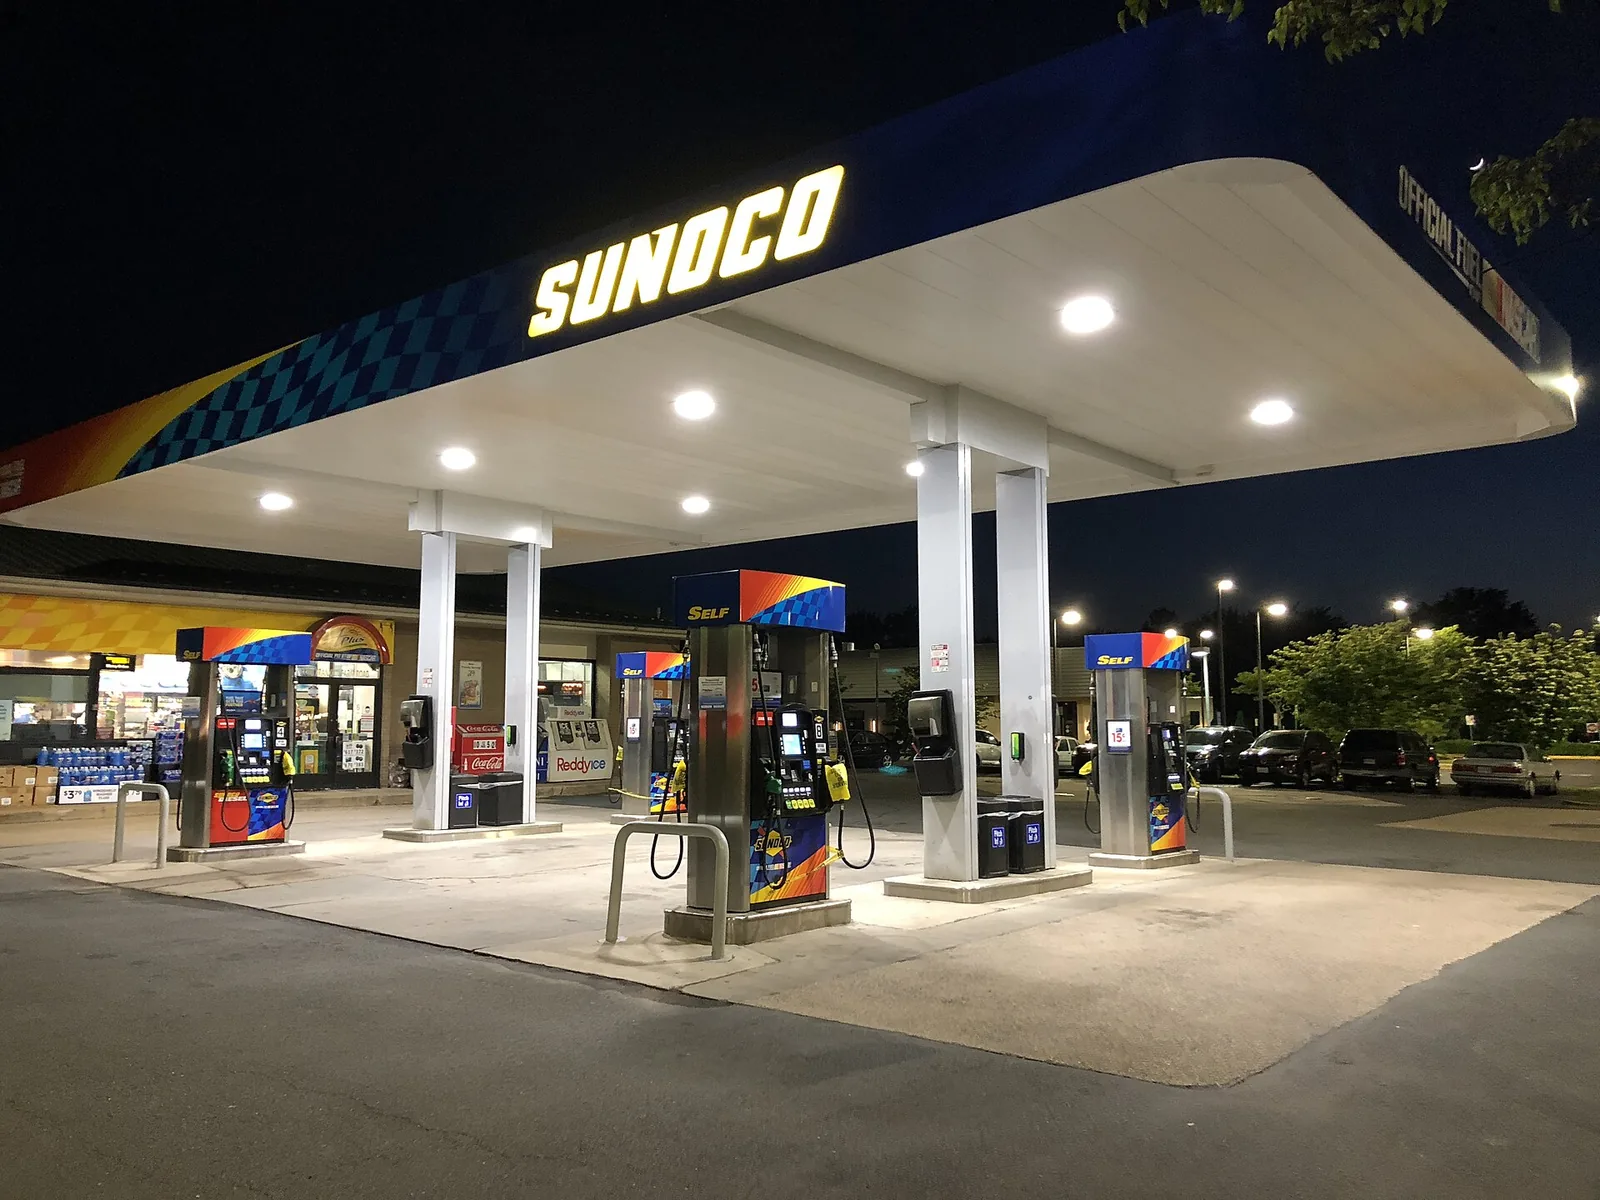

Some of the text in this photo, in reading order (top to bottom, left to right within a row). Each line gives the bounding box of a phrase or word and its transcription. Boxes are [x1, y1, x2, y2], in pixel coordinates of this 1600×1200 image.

[1399, 165, 1455, 260] OFFICIAL
[528, 165, 844, 338] SUNOCO
[688, 605, 730, 621] SELF
[183, 650, 201, 660] SELF
[1097, 655, 1134, 665] SELF
[623, 668, 643, 676] SELF
[277, 728, 284, 737] 4
